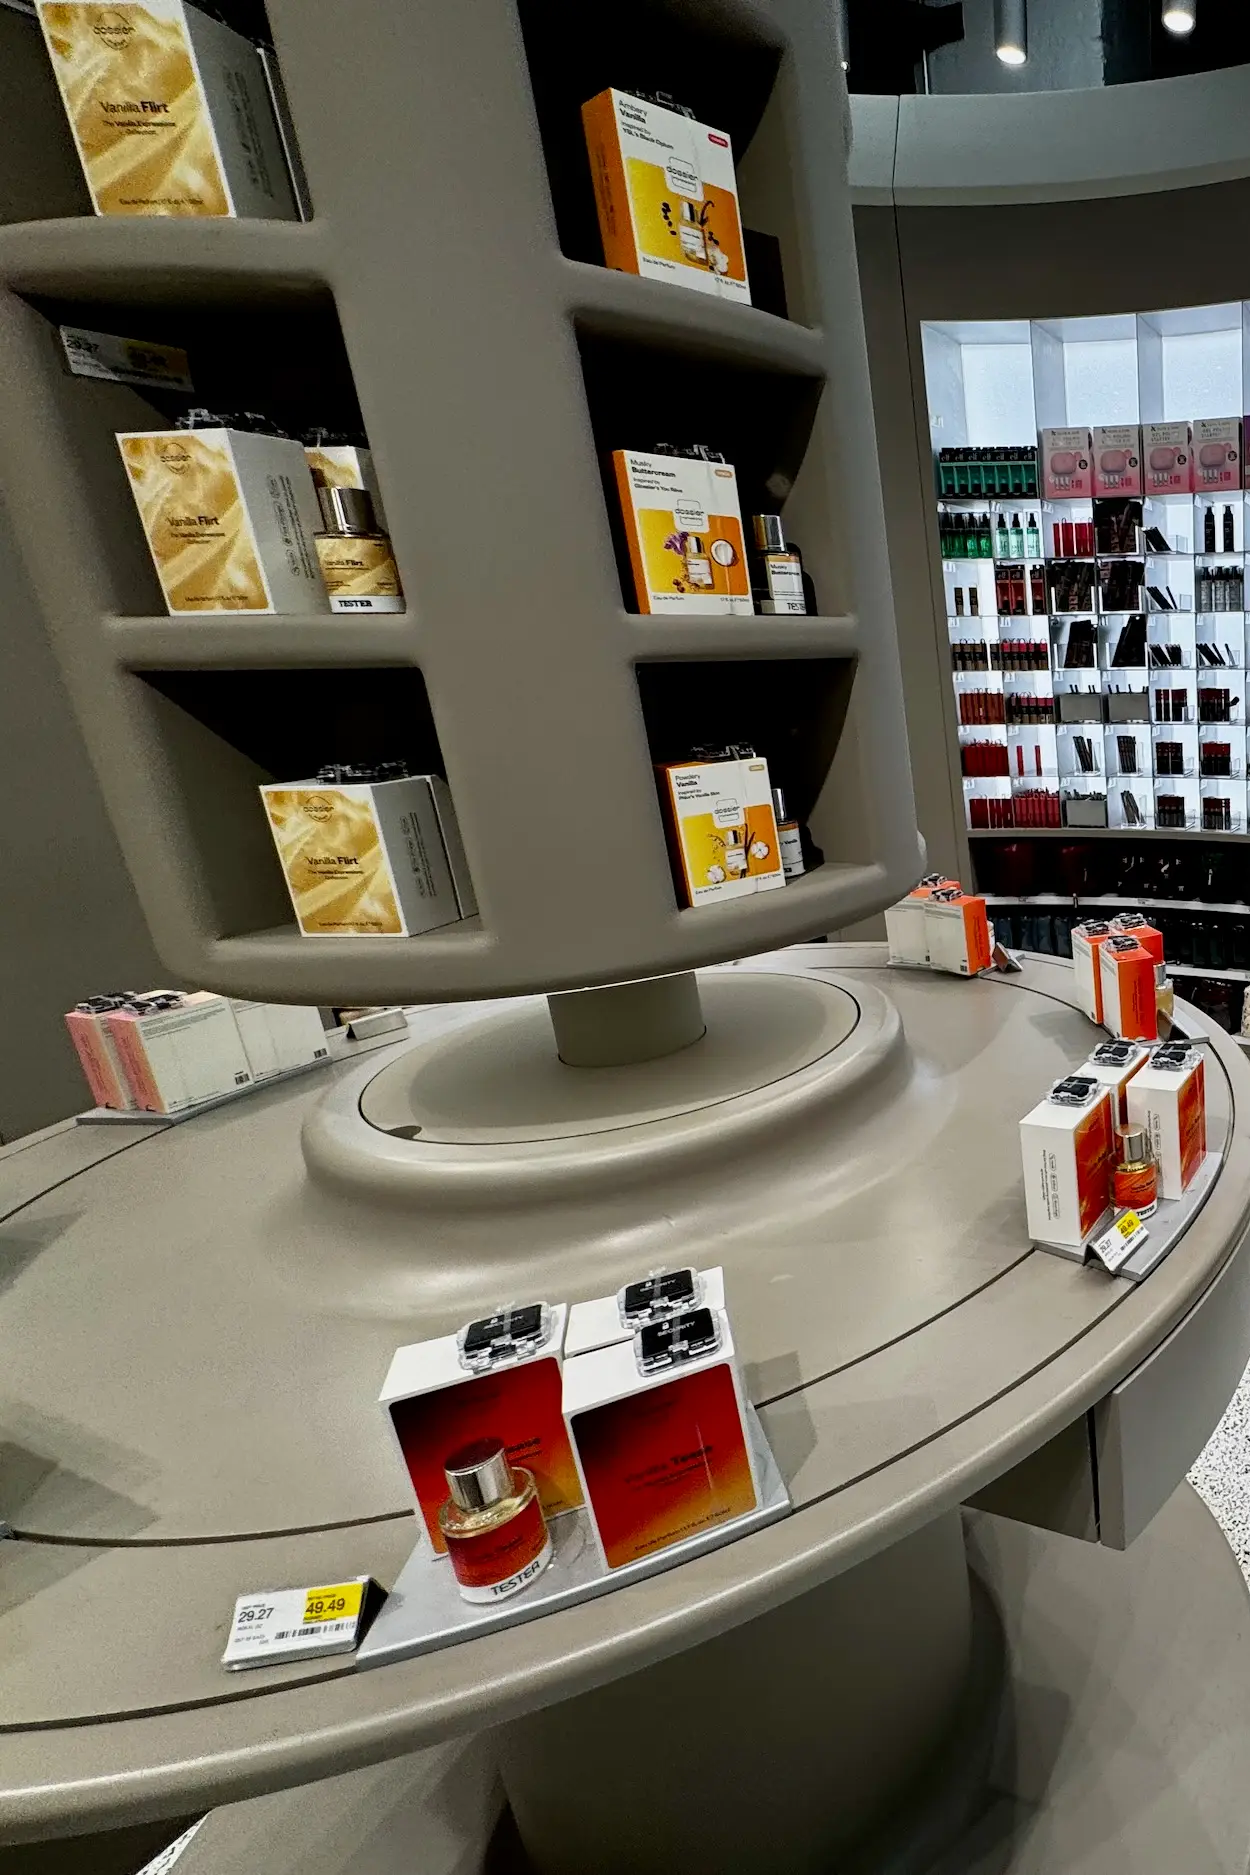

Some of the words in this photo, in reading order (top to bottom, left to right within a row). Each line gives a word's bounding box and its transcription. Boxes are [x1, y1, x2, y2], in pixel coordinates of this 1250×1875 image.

[100, 101, 140, 113] Vanilla
[141, 100, 170, 113] Flirt
[618, 100, 648, 116] Ambery
[620, 108, 646, 124] Vanilla
[666, 166, 698, 181] dossier
[630, 460, 652, 468] Musky
[632, 466, 676, 478] Buttercream
[675, 508, 704, 516] dossier
[168, 516, 198, 527] Vanilla
[198, 516, 218, 526] Flirt
[339, 600, 373, 608] TESTER
[675, 774, 700, 782] Powdery
[676, 780, 698, 788] Vanilla
[714, 806, 740, 814] dossier
[306, 856, 337, 866] Vanilla
[338, 856, 358, 865] Flirt
[657, 1320, 696, 1337] SECURITY
[490, 1560, 541, 1596] TESTER
[305, 1598, 346, 1615] 49.49
[238, 1608, 274, 1624] 29.27
